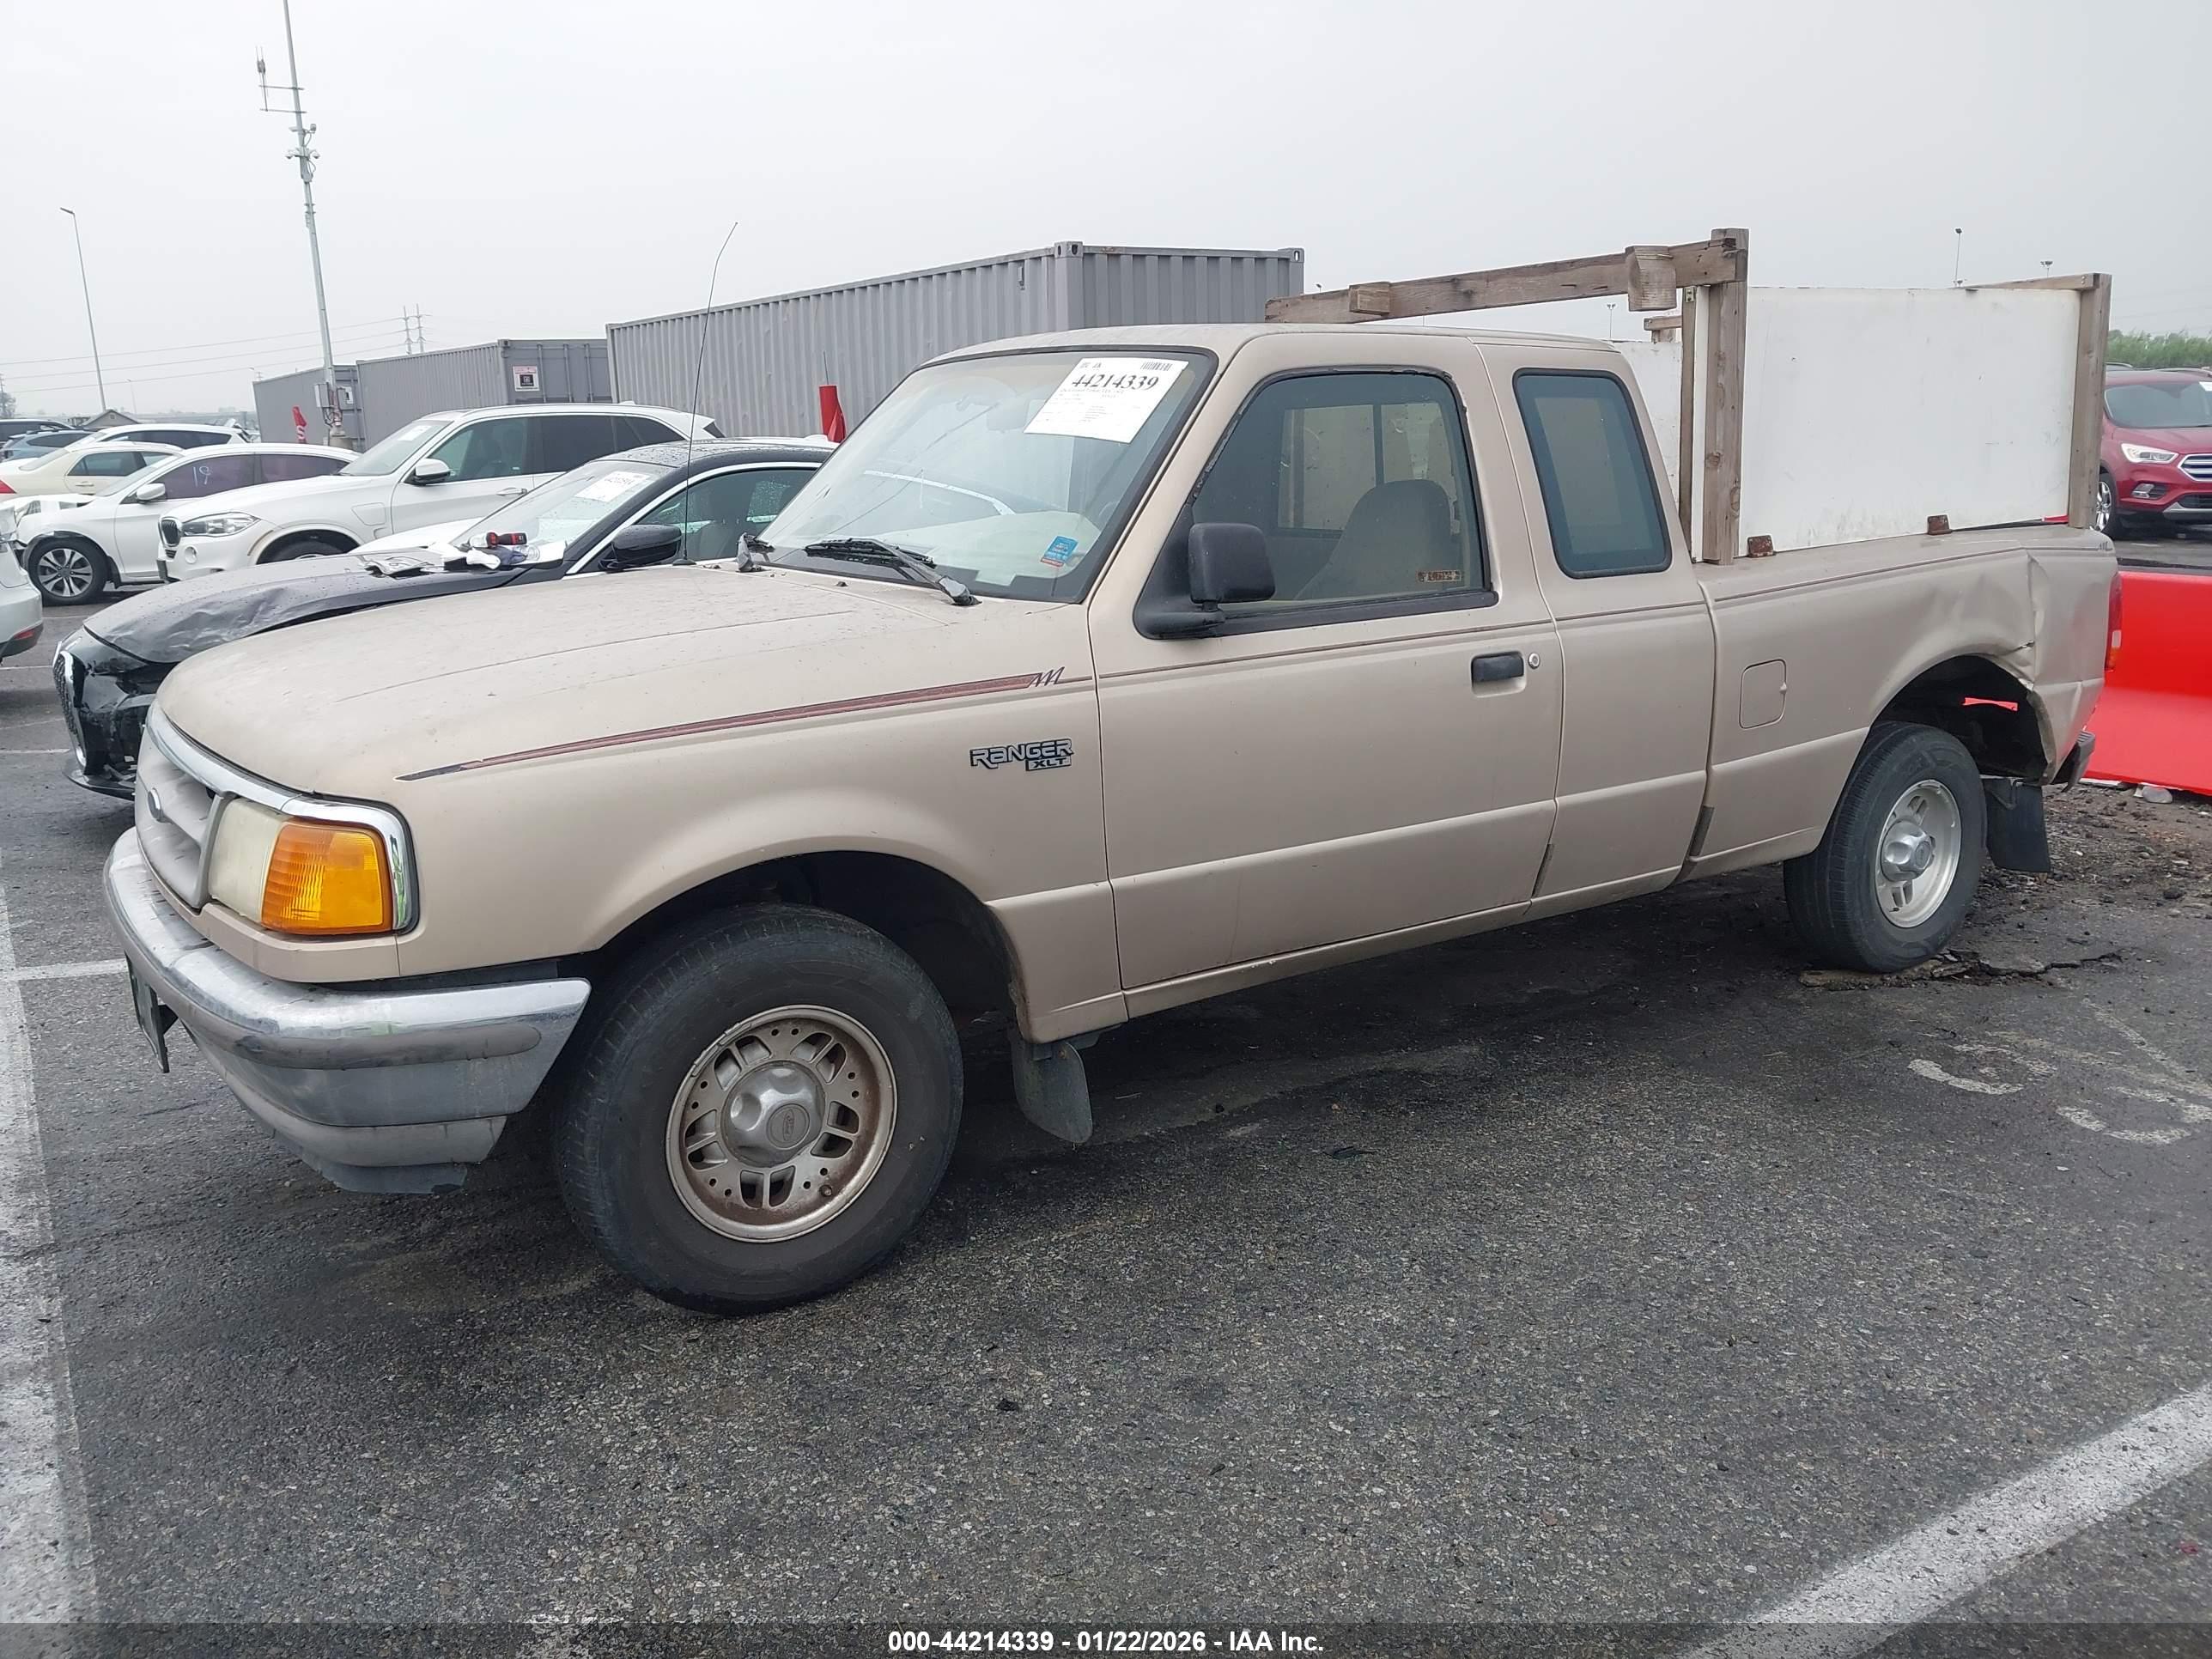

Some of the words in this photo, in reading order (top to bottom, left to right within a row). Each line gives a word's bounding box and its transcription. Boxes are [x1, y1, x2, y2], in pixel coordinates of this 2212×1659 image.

[1072, 374, 1159, 391] 44214339
[969, 738, 1073, 769] RANGER
[1031, 757, 1069, 769] XLT
